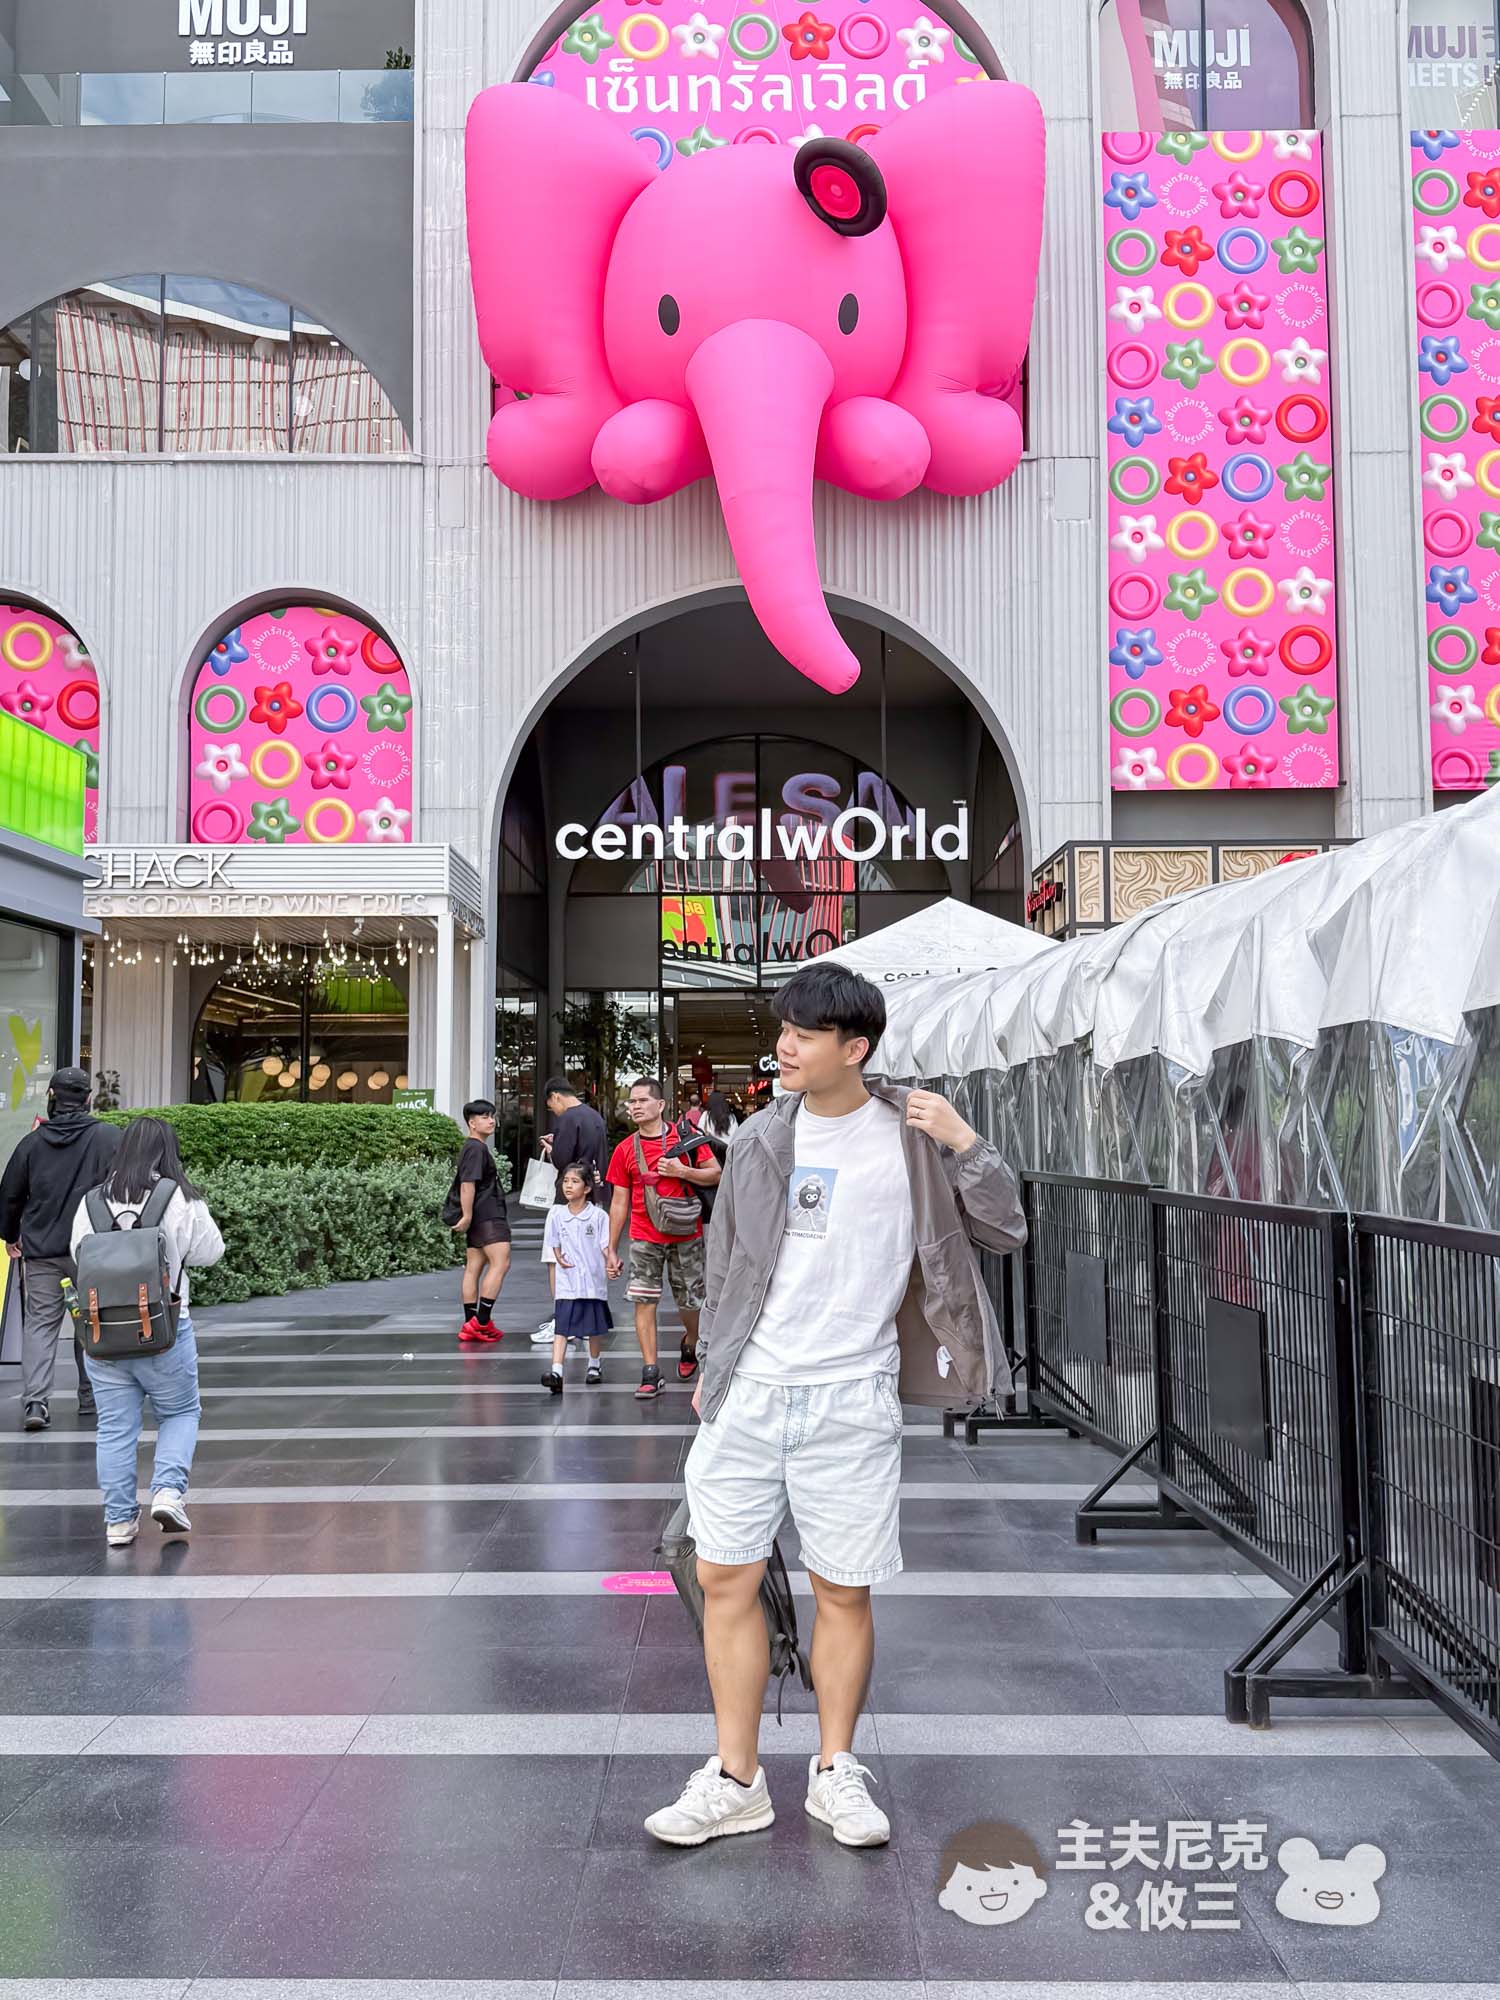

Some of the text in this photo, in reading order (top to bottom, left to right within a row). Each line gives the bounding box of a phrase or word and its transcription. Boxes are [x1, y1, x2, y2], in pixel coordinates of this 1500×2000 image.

[178, 0, 307, 36] MUJI
[189, 39, 294, 65] 無印良品
[1153, 28, 1251, 68] MUJI
[585, 58, 929, 113] เซ็นทรัลเวิลด์
[1164, 71, 1243, 90] 無印良品
[555, 806, 969, 862] centralwOrld
[84, 894, 428, 915] ES SODA BEER WINE FRIES
